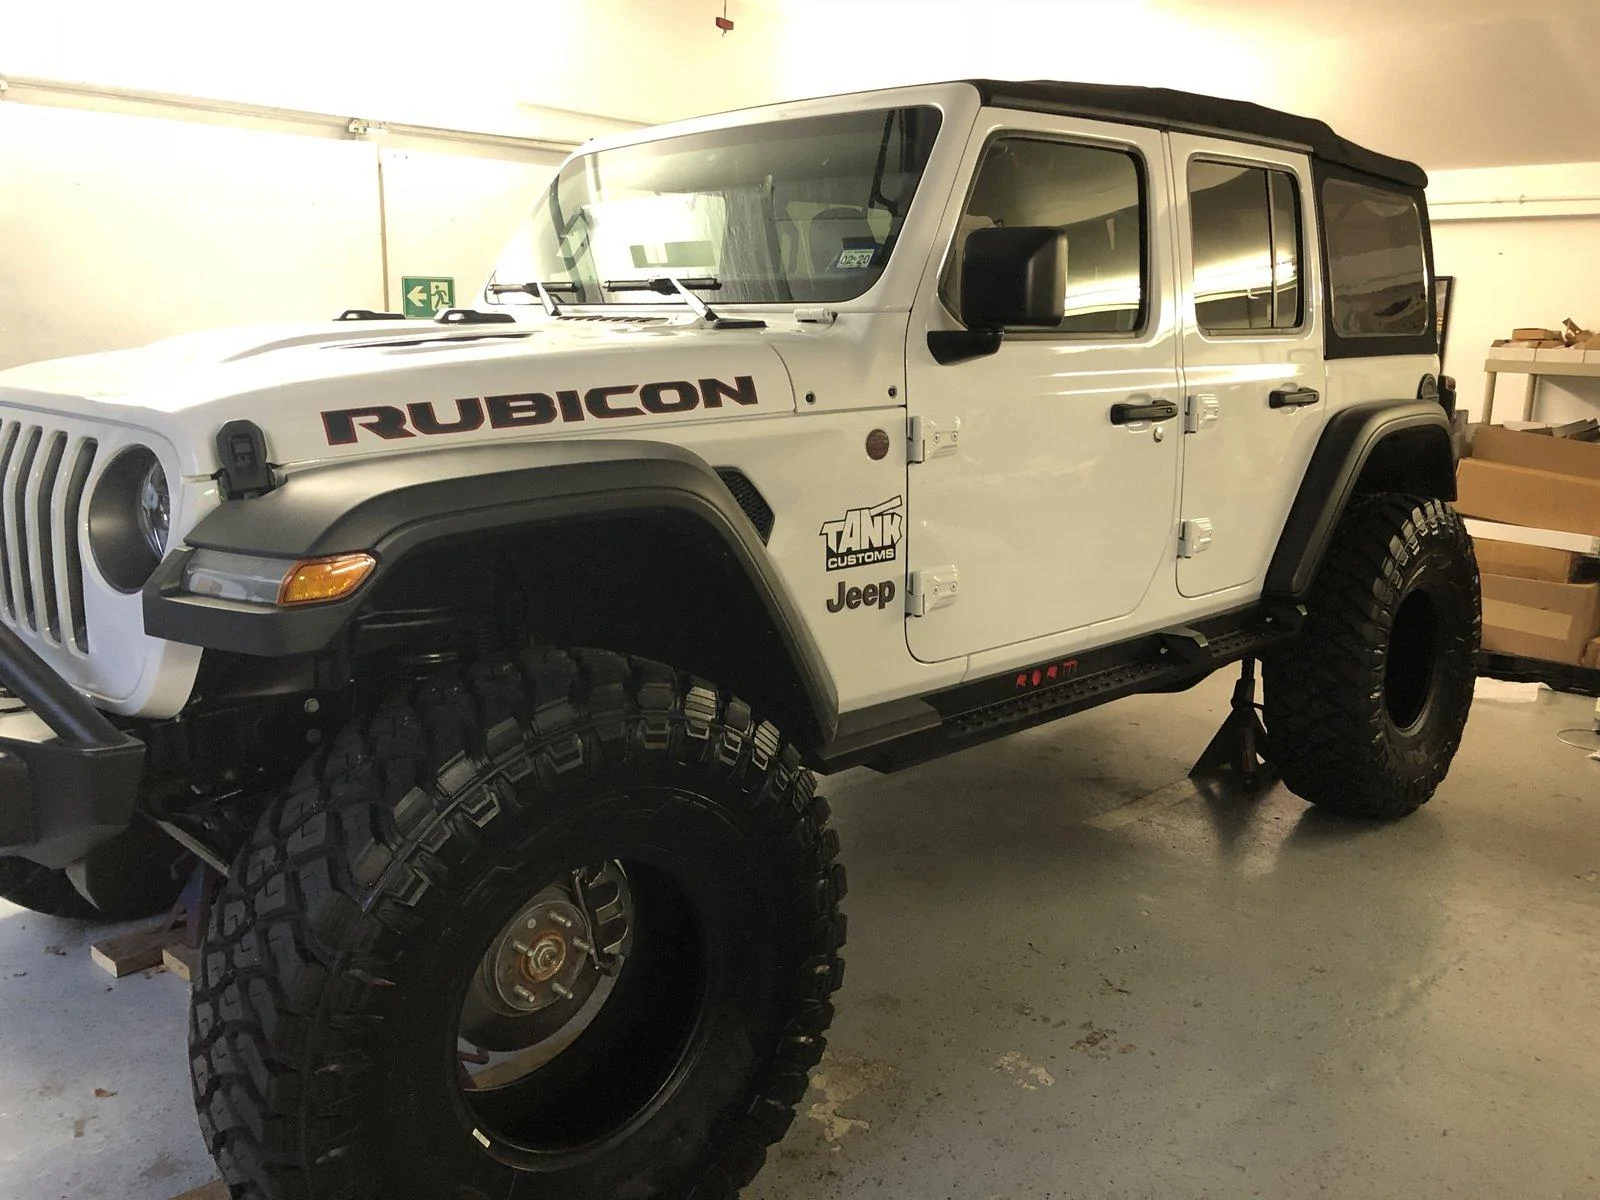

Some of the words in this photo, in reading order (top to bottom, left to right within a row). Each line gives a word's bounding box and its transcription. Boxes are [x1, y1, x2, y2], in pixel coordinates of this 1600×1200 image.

[320, 375, 759, 446] RUBICON
[819, 495, 903, 554] TANK
[827, 548, 895, 569] CUSTOMS
[826, 580, 896, 614] Jeep
